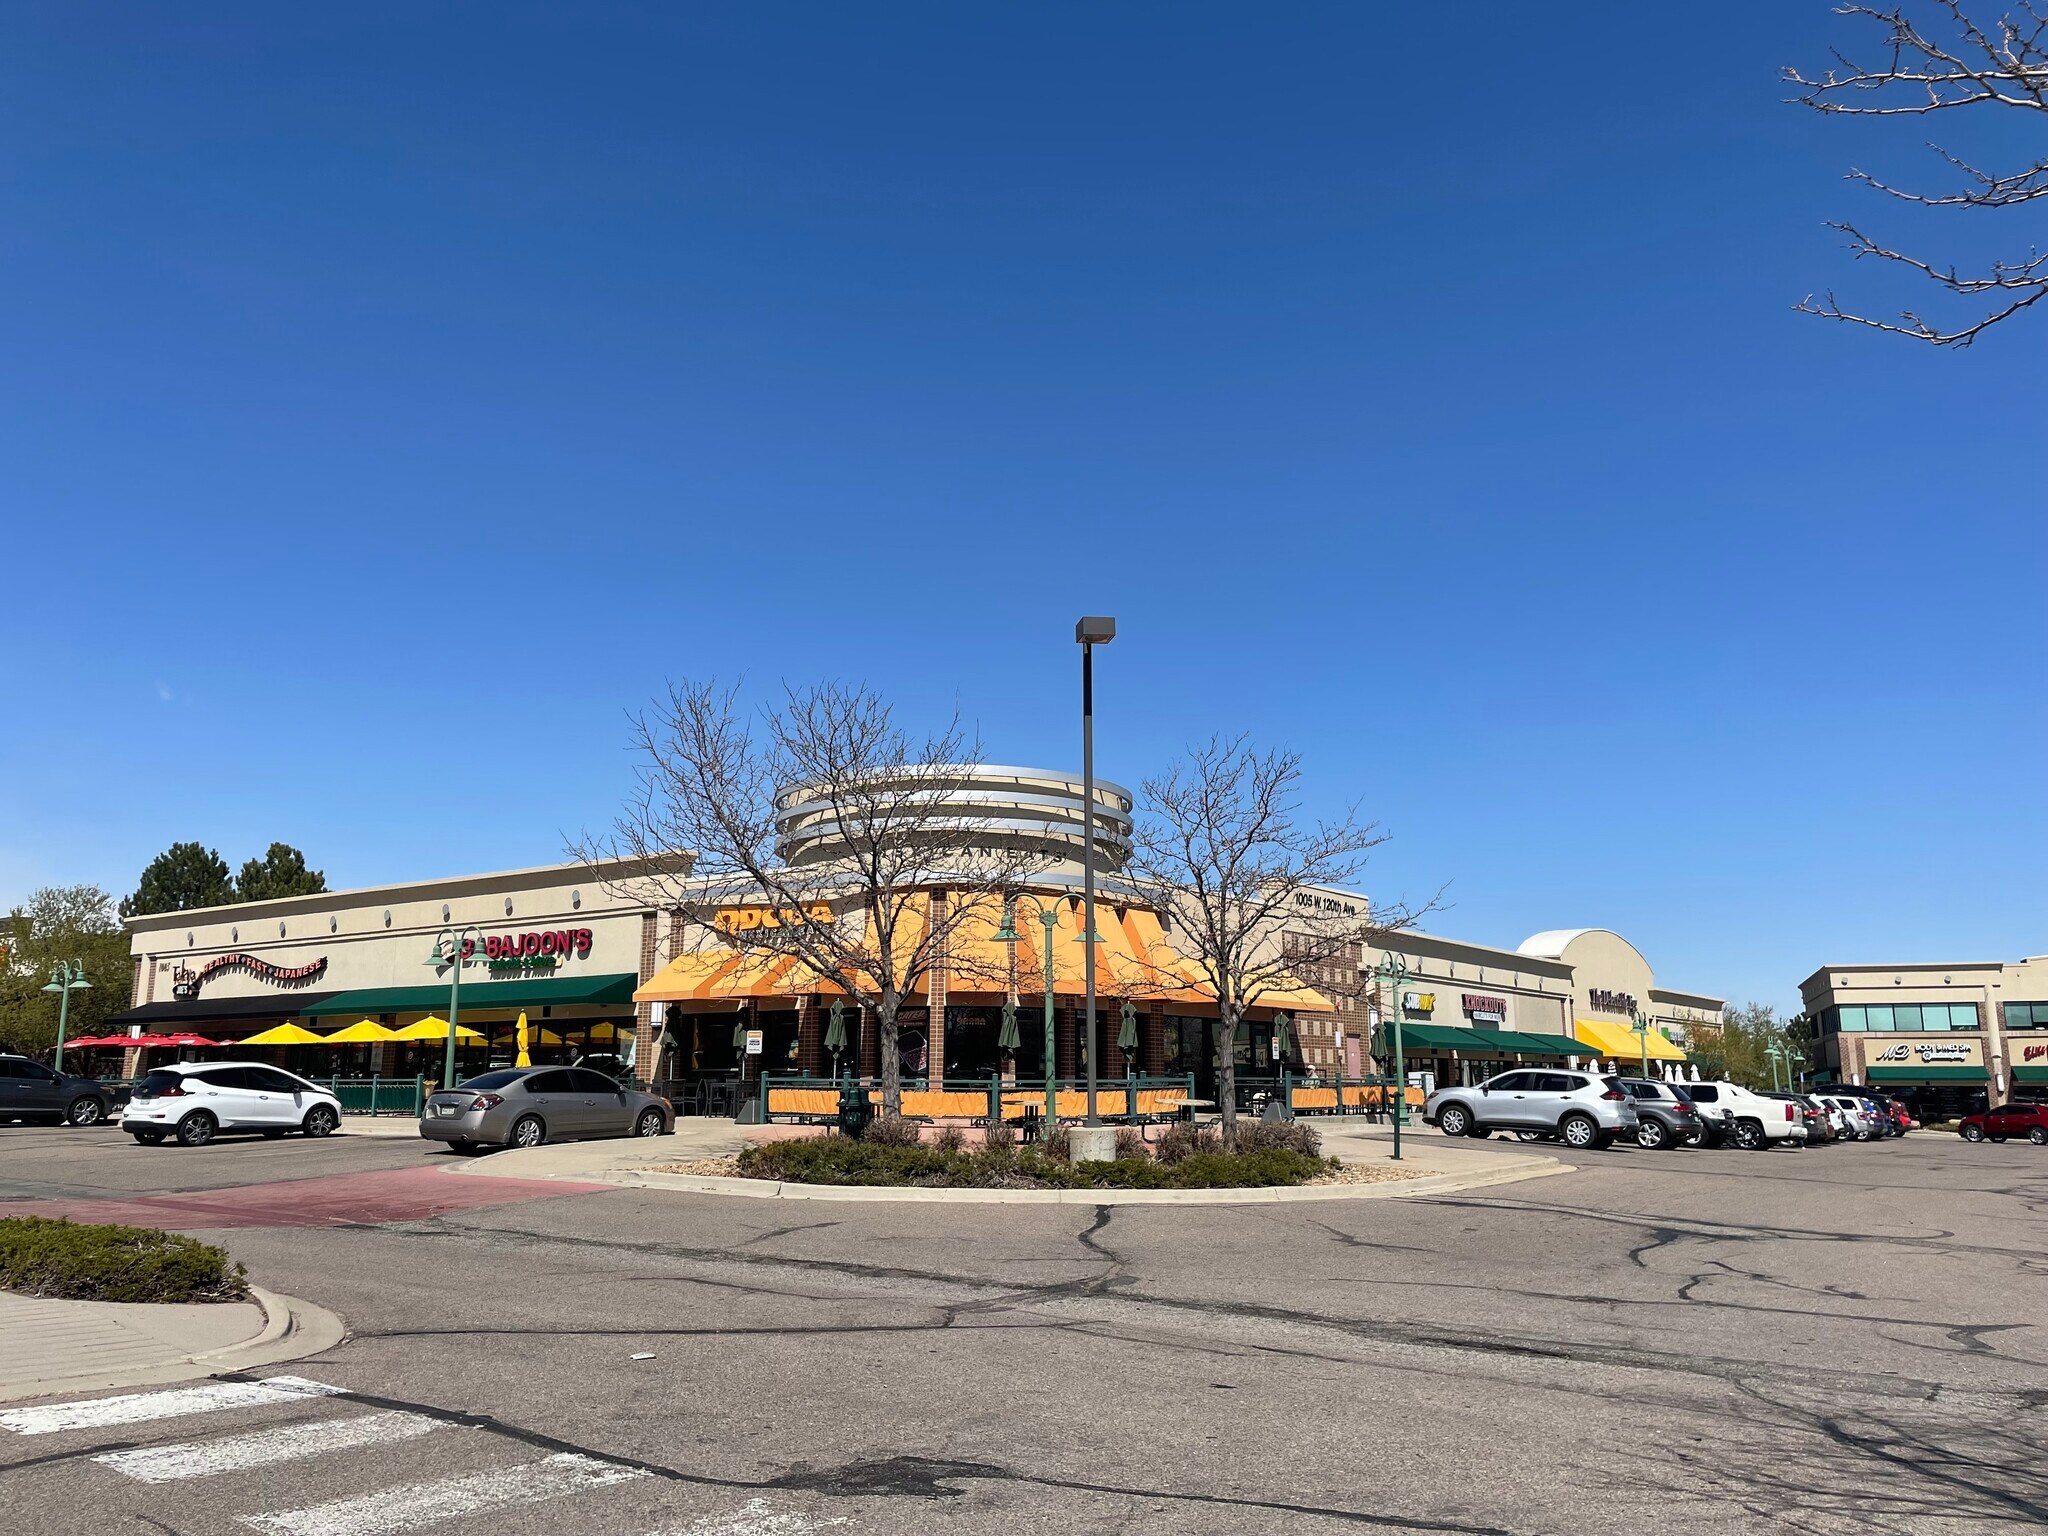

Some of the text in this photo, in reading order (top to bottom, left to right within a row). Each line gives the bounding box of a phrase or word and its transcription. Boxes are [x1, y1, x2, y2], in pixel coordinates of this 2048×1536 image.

[1295, 892, 1312, 907] 1005
[1323, 898, 1341, 913] 120th
[460, 928, 590, 959] BBAJOON'S
[203, 954, 321, 979] HEALTHY FAST JAPANESE
[1405, 993, 1436, 1010] SUBWAY
[1464, 994, 1506, 1013] KNOCKOUTS
